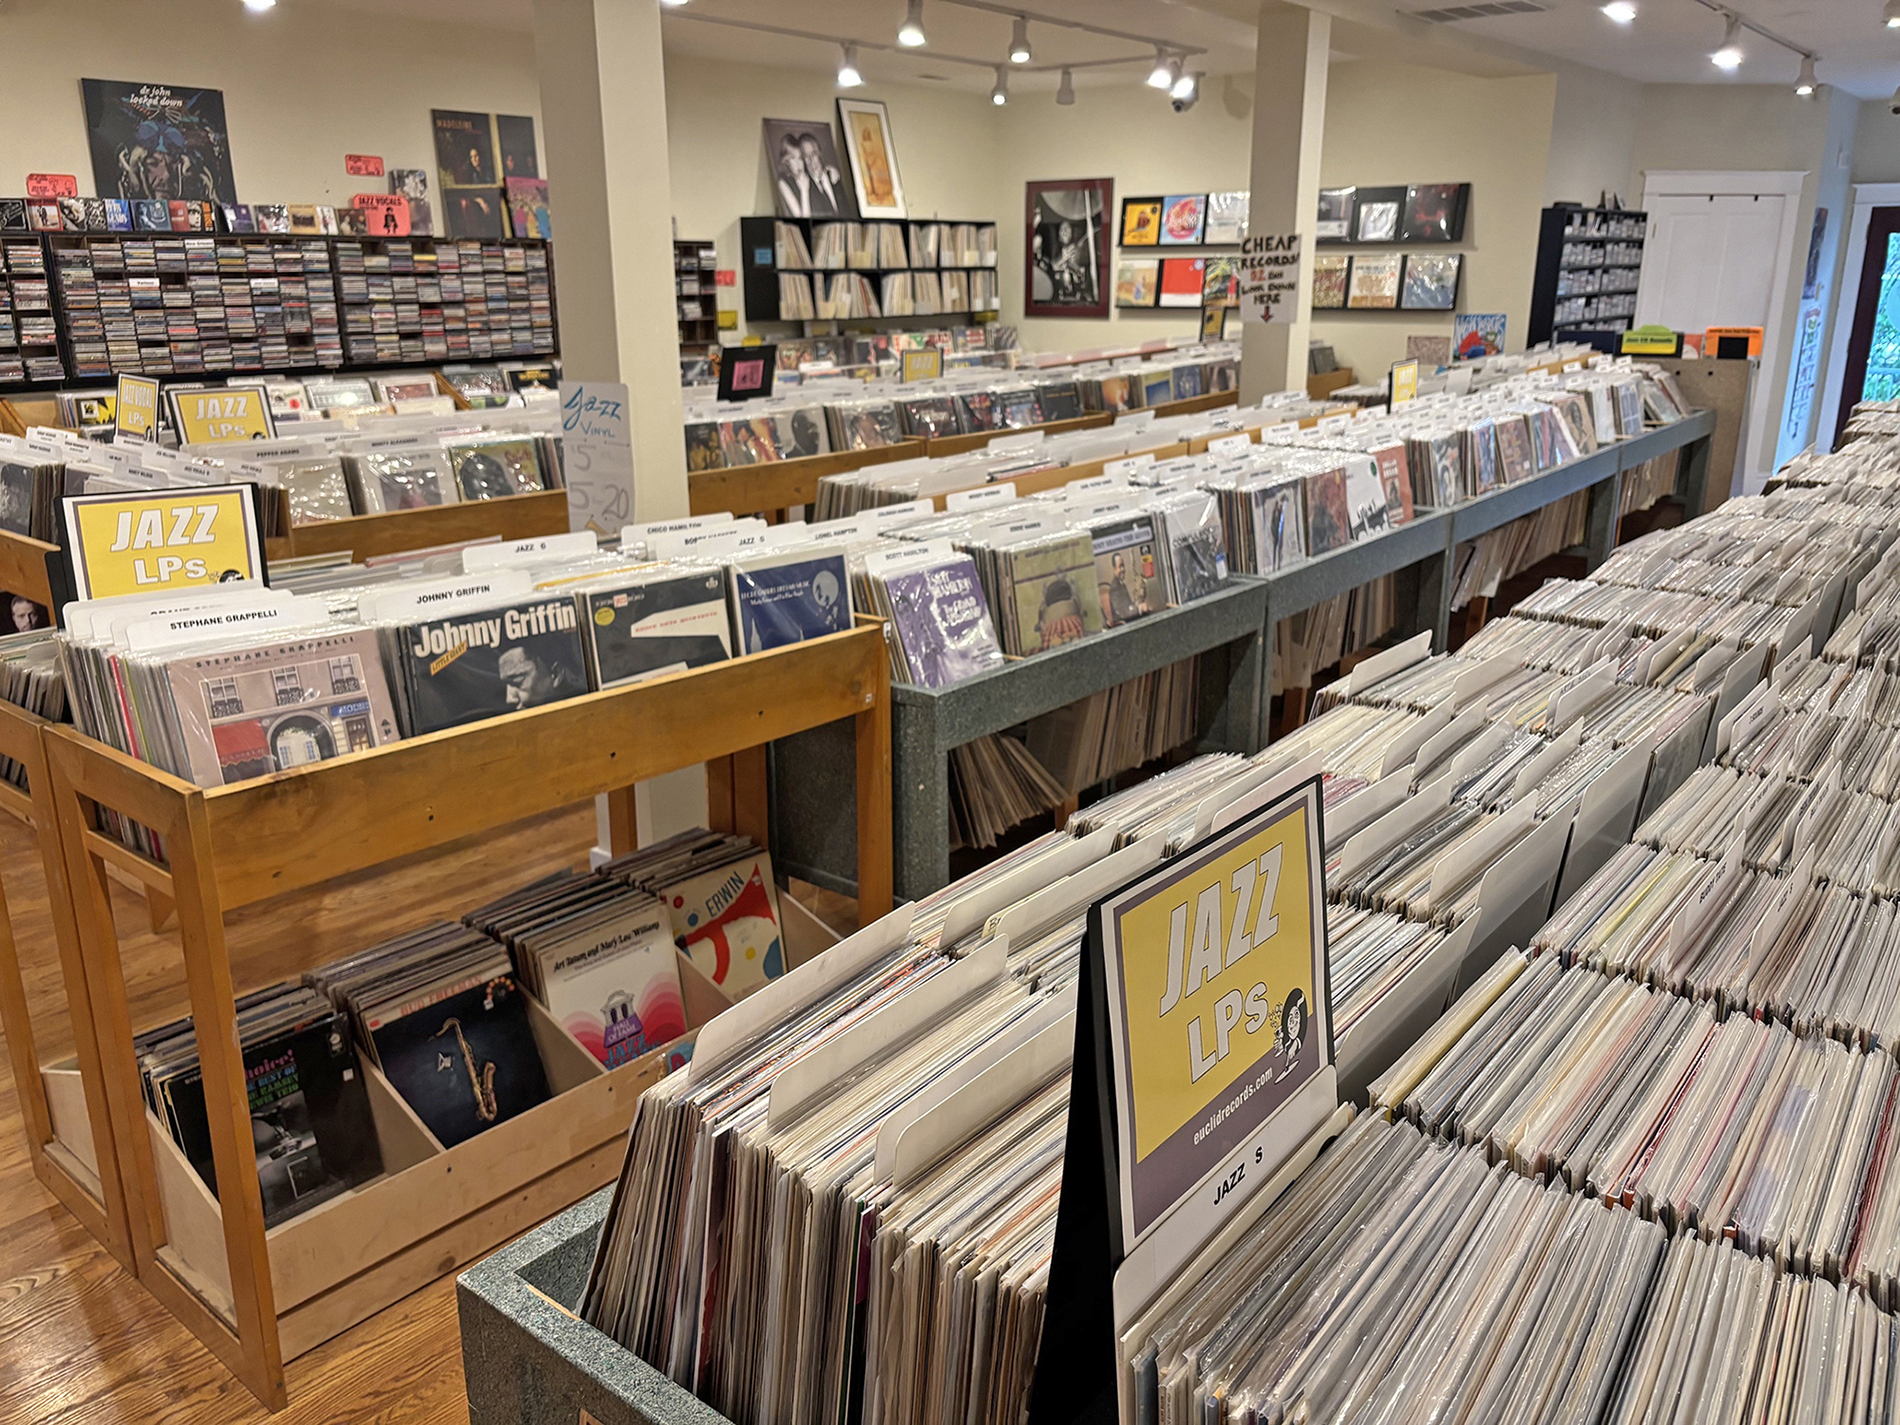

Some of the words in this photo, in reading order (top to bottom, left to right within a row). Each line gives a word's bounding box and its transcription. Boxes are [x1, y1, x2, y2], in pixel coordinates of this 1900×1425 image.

[151, 86, 171, 97] john
[159, 96, 183, 107] down
[1242, 235, 1297, 254] CHEAP
[196, 396, 248, 420] JAZZ
[208, 422, 245, 438] LPs
[110, 504, 219, 553] JAZZ
[647, 526, 669, 535] CHICO
[738, 537, 756, 547] JAZZ
[515, 544, 535, 554] JAZZ
[133, 556, 207, 585] LPs
[417, 590, 454, 604] JOHNNY
[456, 584, 491, 598] GRIFFIN
[170, 617, 224, 631] STEPHANE
[225, 609, 278, 623] GRAPPELLI
[414, 618, 501, 658] Johnny
[504, 601, 577, 641] Griffin
[196, 649, 272, 669] STEPHANE
[279, 635, 356, 655] GRAPPELLI
[705, 870, 745, 918] ERWIN
[1159, 841, 1283, 1018] JAZZ
[553, 960, 565, 973] Art
[565, 952, 588, 966] Tatum
[600, 936, 618, 952] Mary
[619, 931, 632, 944] Lou
[632, 921, 660, 937] Williams
[605, 1033, 646, 1064] JAZZ
[243, 1048, 295, 1079] hoice!
[1193, 1066, 1273, 1146] euclidrecords.com
[1213, 1162, 1246, 1206] JAZZ
[1255, 1146, 1263, 1164] S
